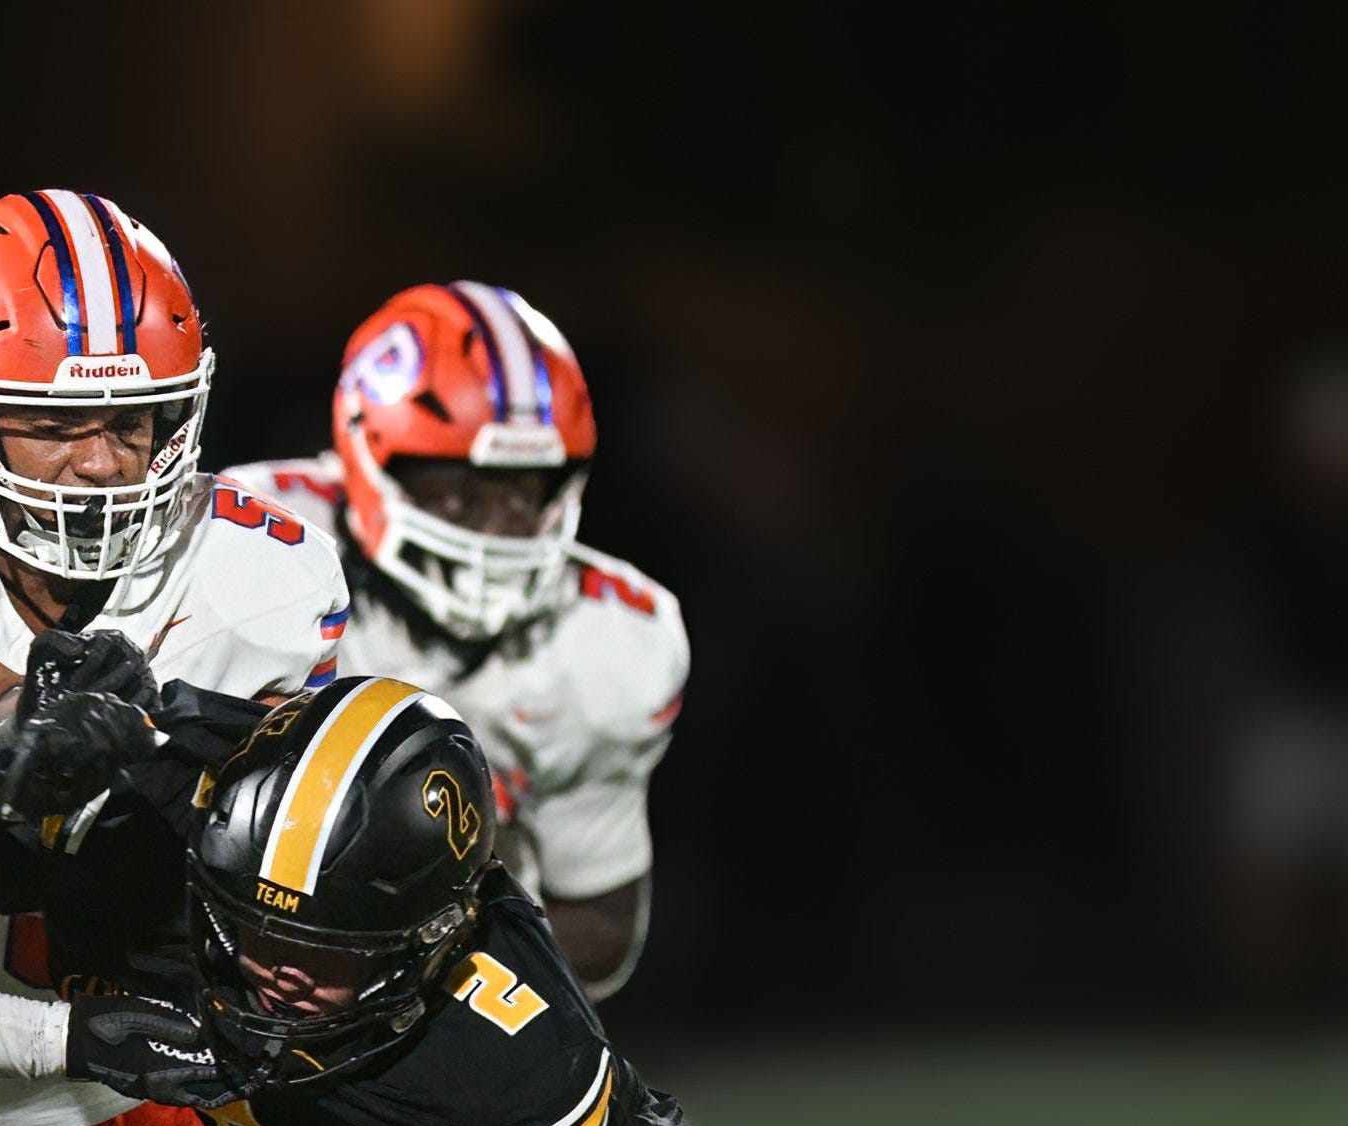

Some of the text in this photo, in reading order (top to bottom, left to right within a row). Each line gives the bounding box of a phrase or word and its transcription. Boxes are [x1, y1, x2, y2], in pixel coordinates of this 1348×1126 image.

[69, 362, 141, 379] Riddell
[422, 769, 483, 861] 2
[255, 880, 300, 915] TEAM
[451, 950, 551, 1038] 2
